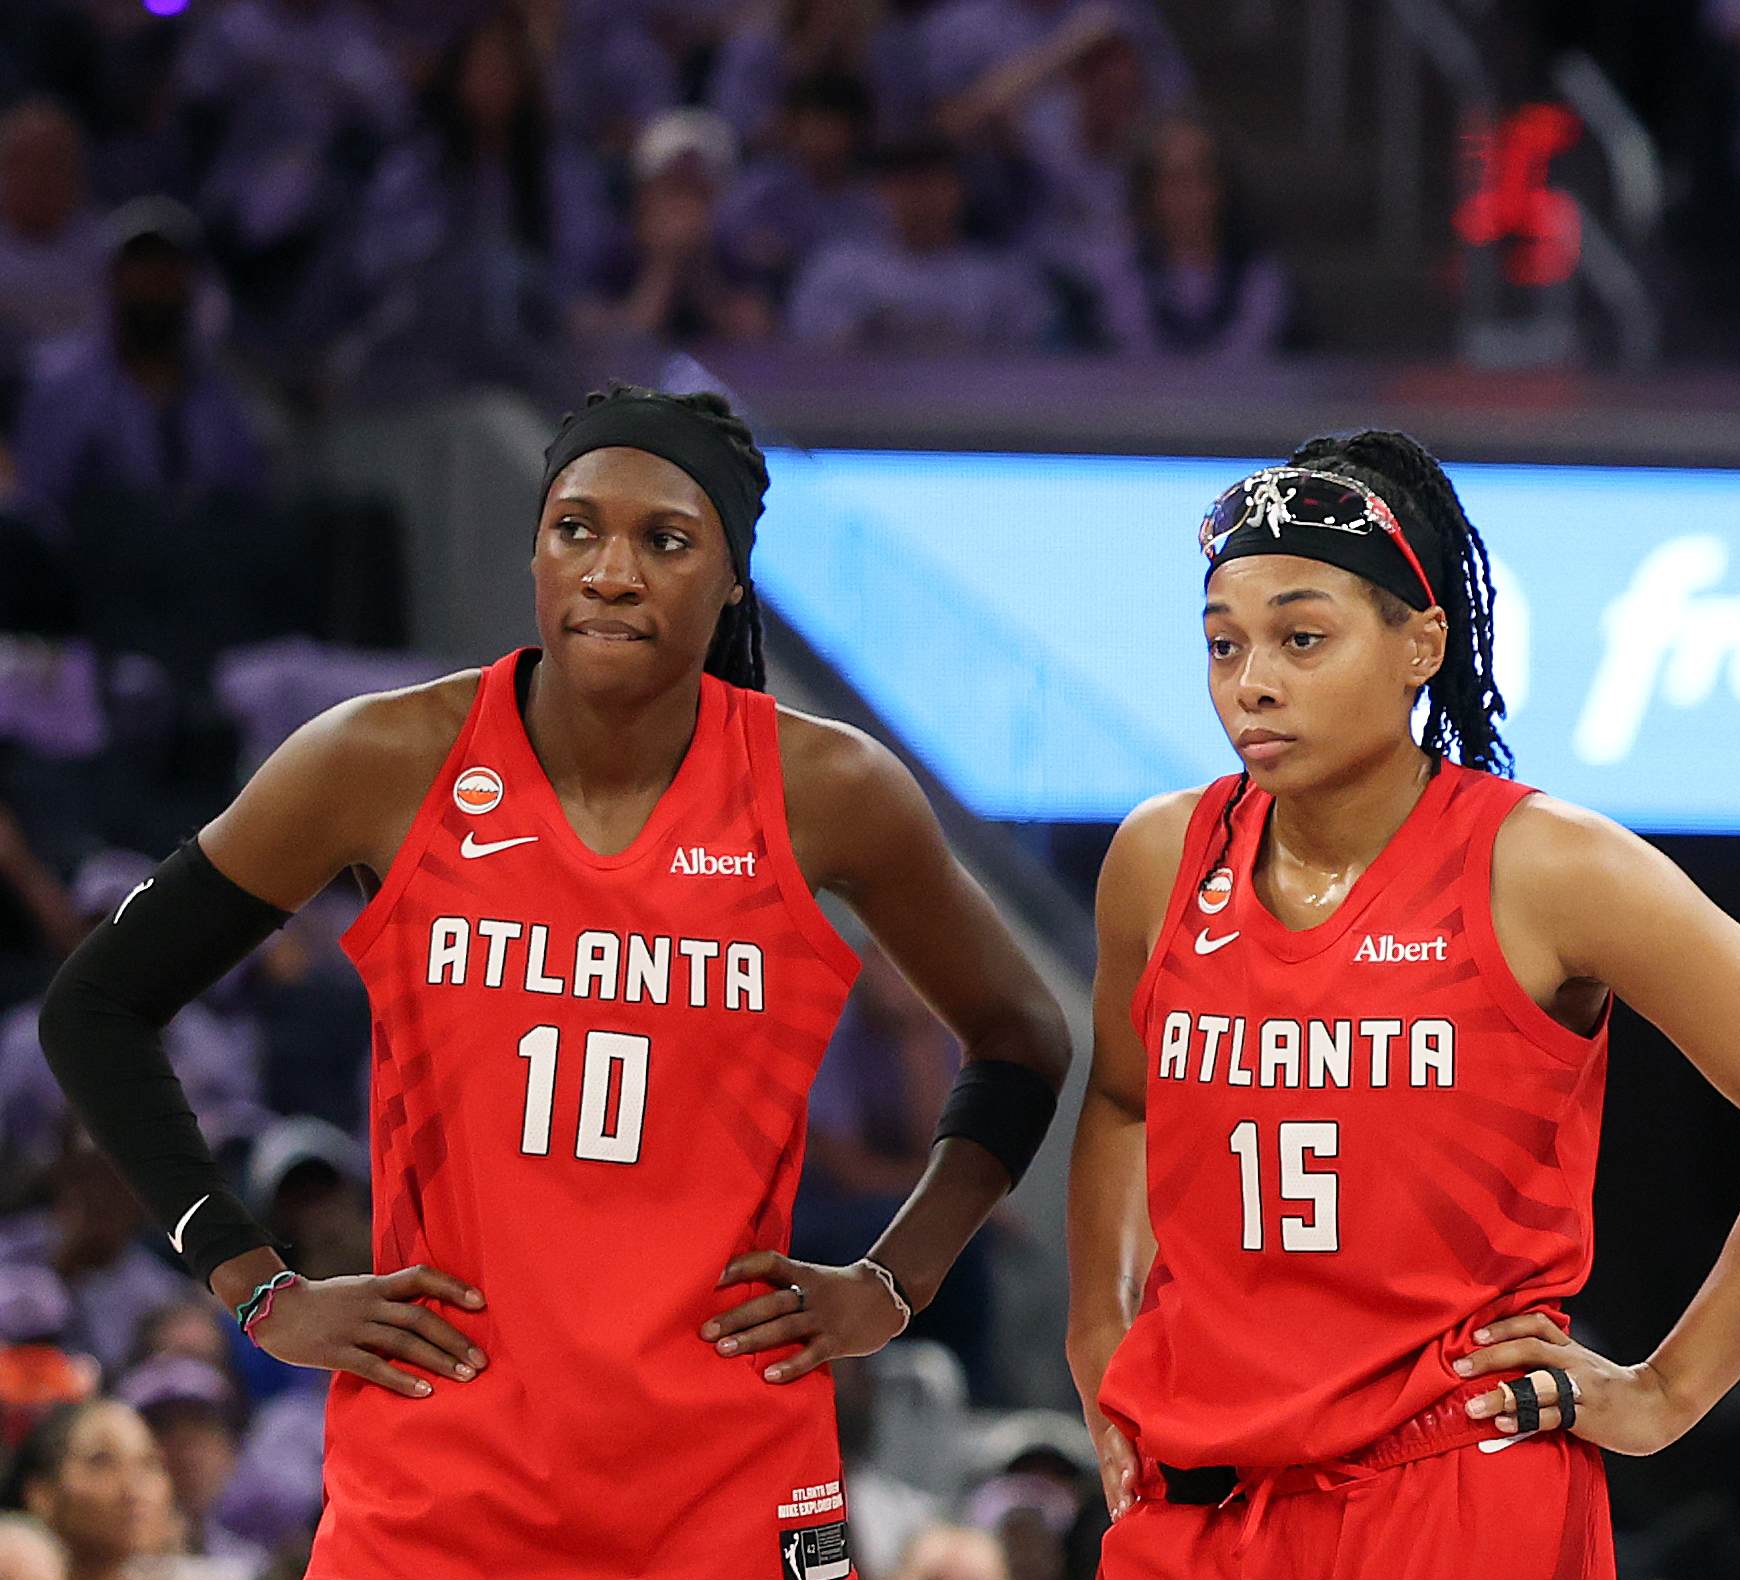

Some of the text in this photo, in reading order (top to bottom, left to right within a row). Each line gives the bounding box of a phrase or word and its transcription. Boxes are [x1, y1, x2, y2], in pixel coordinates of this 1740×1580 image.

[669, 845, 757, 878] Albert
[426, 915, 765, 1013] ATLANTA
[1352, 932, 1449, 964] Albert
[516, 1023, 651, 1165] 10
[1157, 1010, 1456, 1090] ATLANTA
[1228, 1120, 1340, 1253] 15
